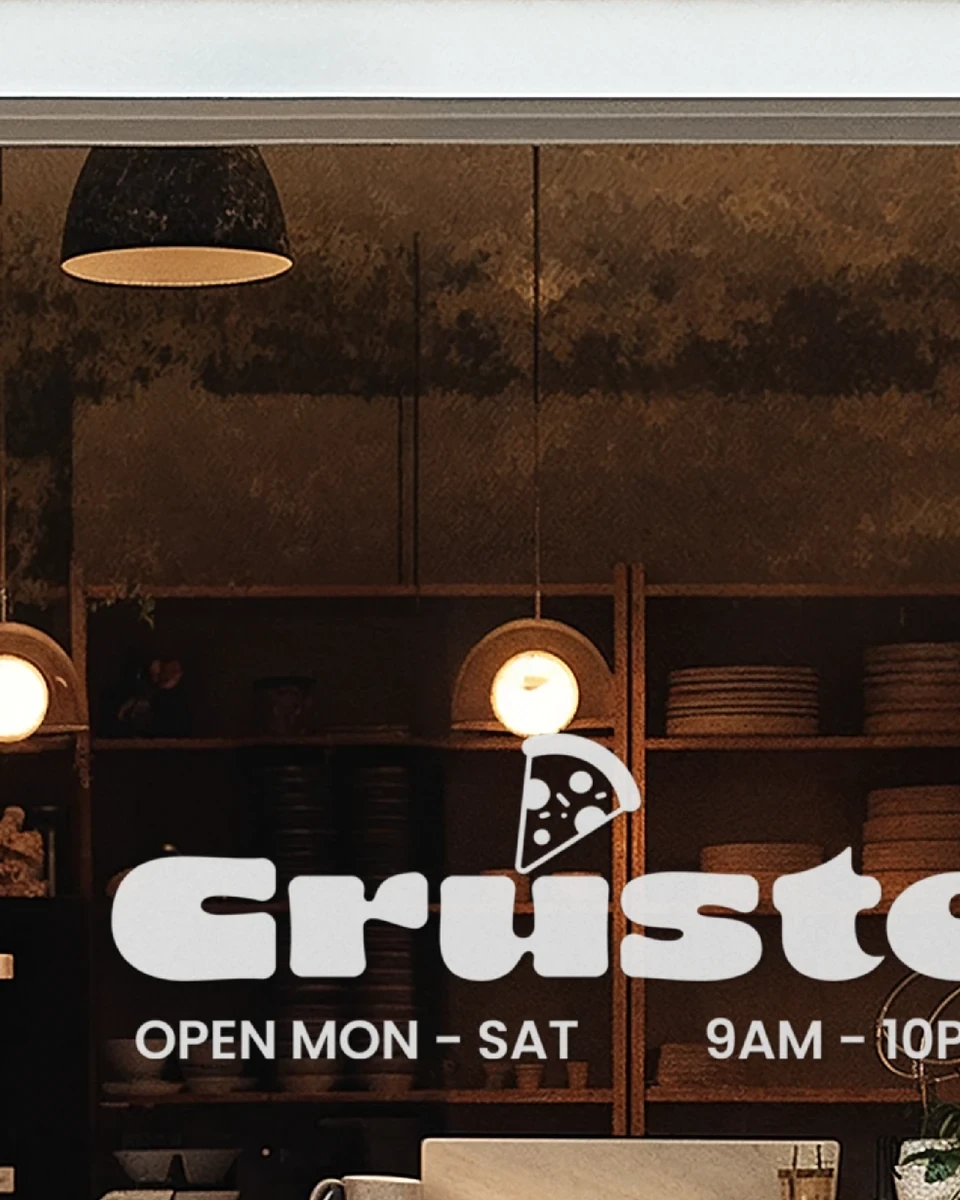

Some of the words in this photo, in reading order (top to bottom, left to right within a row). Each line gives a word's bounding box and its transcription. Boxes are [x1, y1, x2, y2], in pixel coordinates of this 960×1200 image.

[135, 1020, 275, 1060] OPEN
[292, 1020, 418, 1060] MON
[479, 1019, 579, 1060] SAT
[706, 1017, 822, 1060] 9AM
